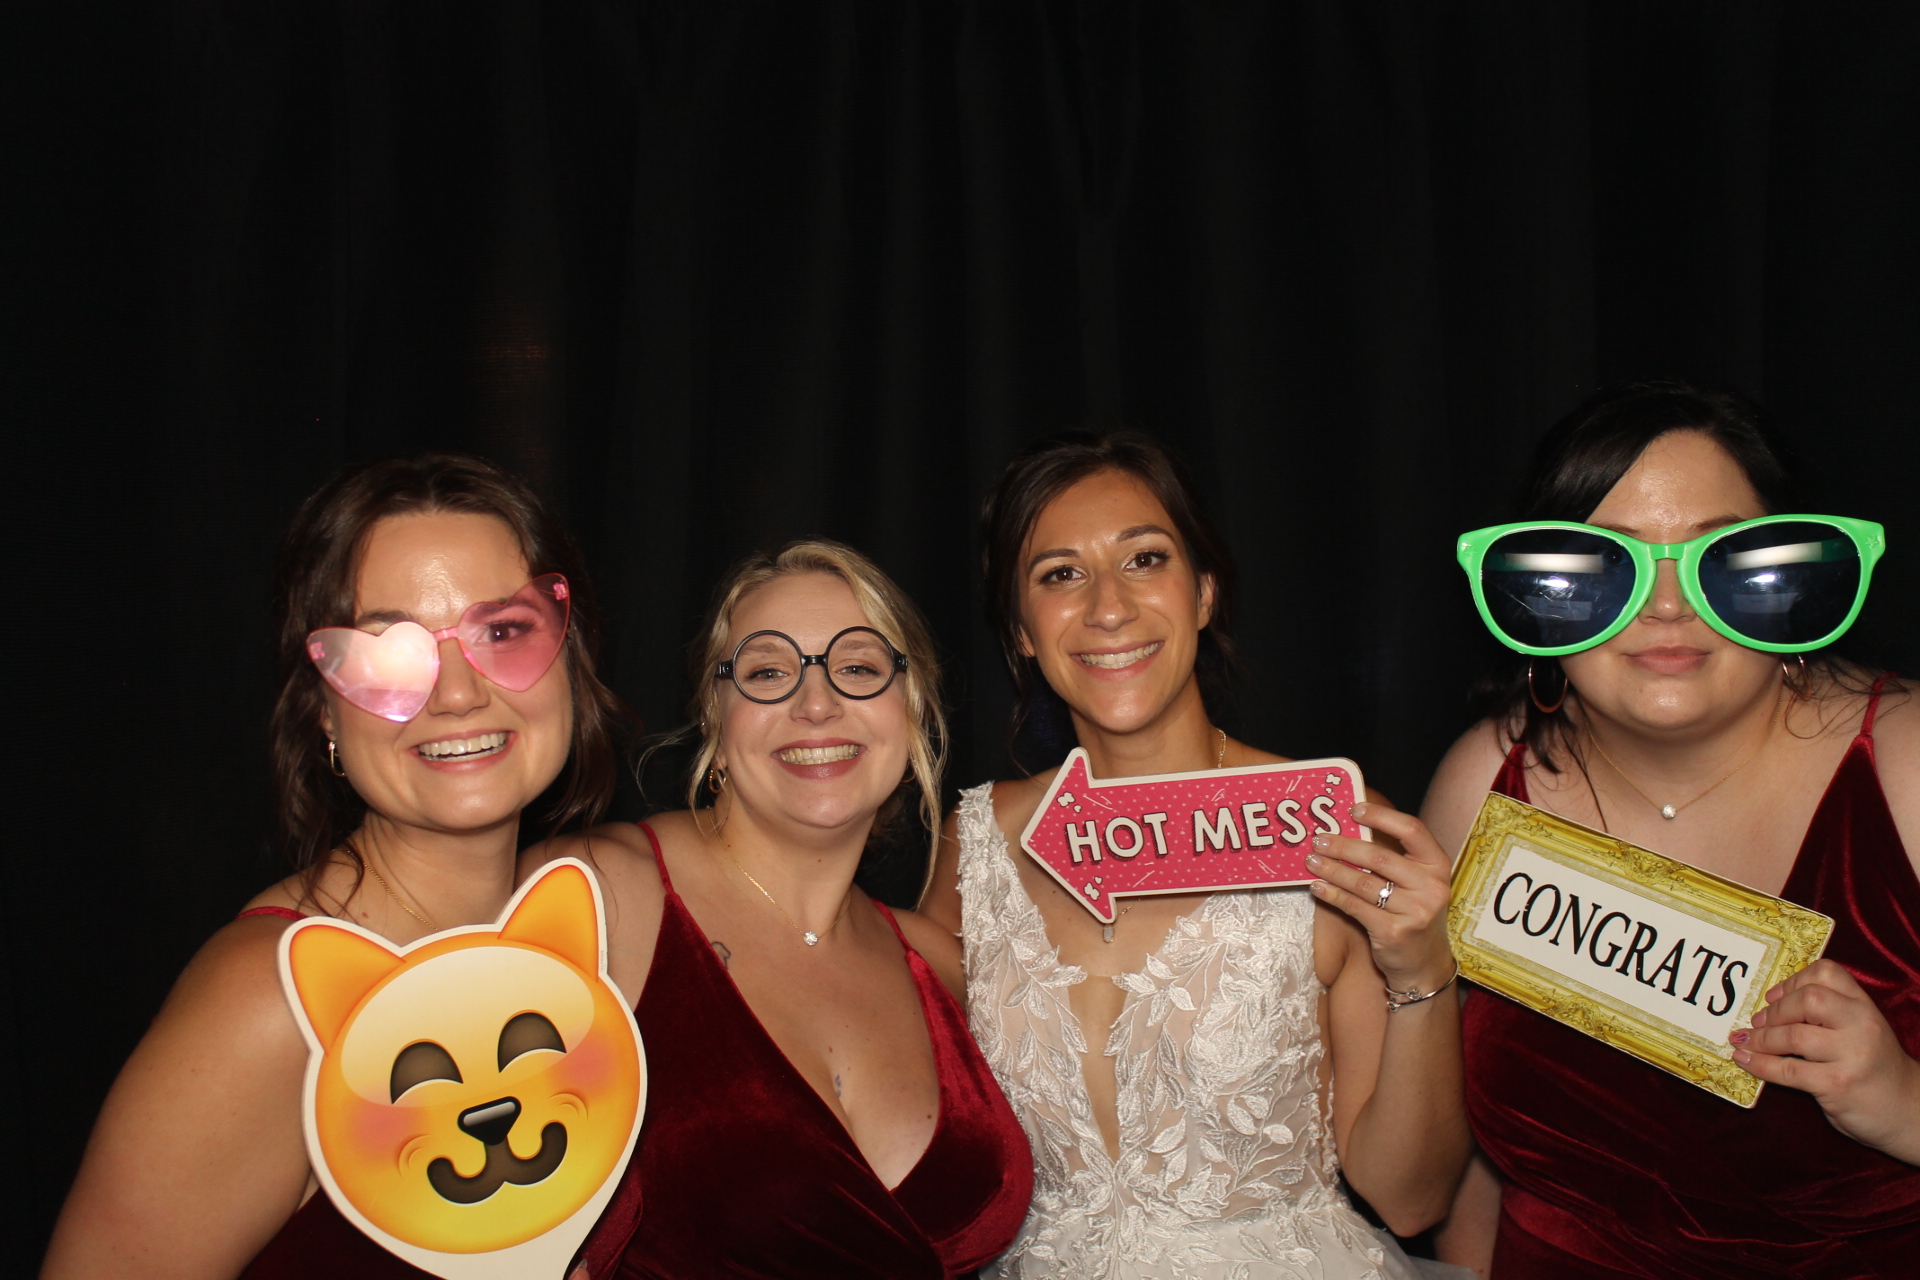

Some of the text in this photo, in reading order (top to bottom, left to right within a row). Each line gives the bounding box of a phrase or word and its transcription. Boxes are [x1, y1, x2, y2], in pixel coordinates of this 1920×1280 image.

[1065, 795, 1341, 864] HOT MESS
[1493, 871, 1749, 1017] CONGRATS
